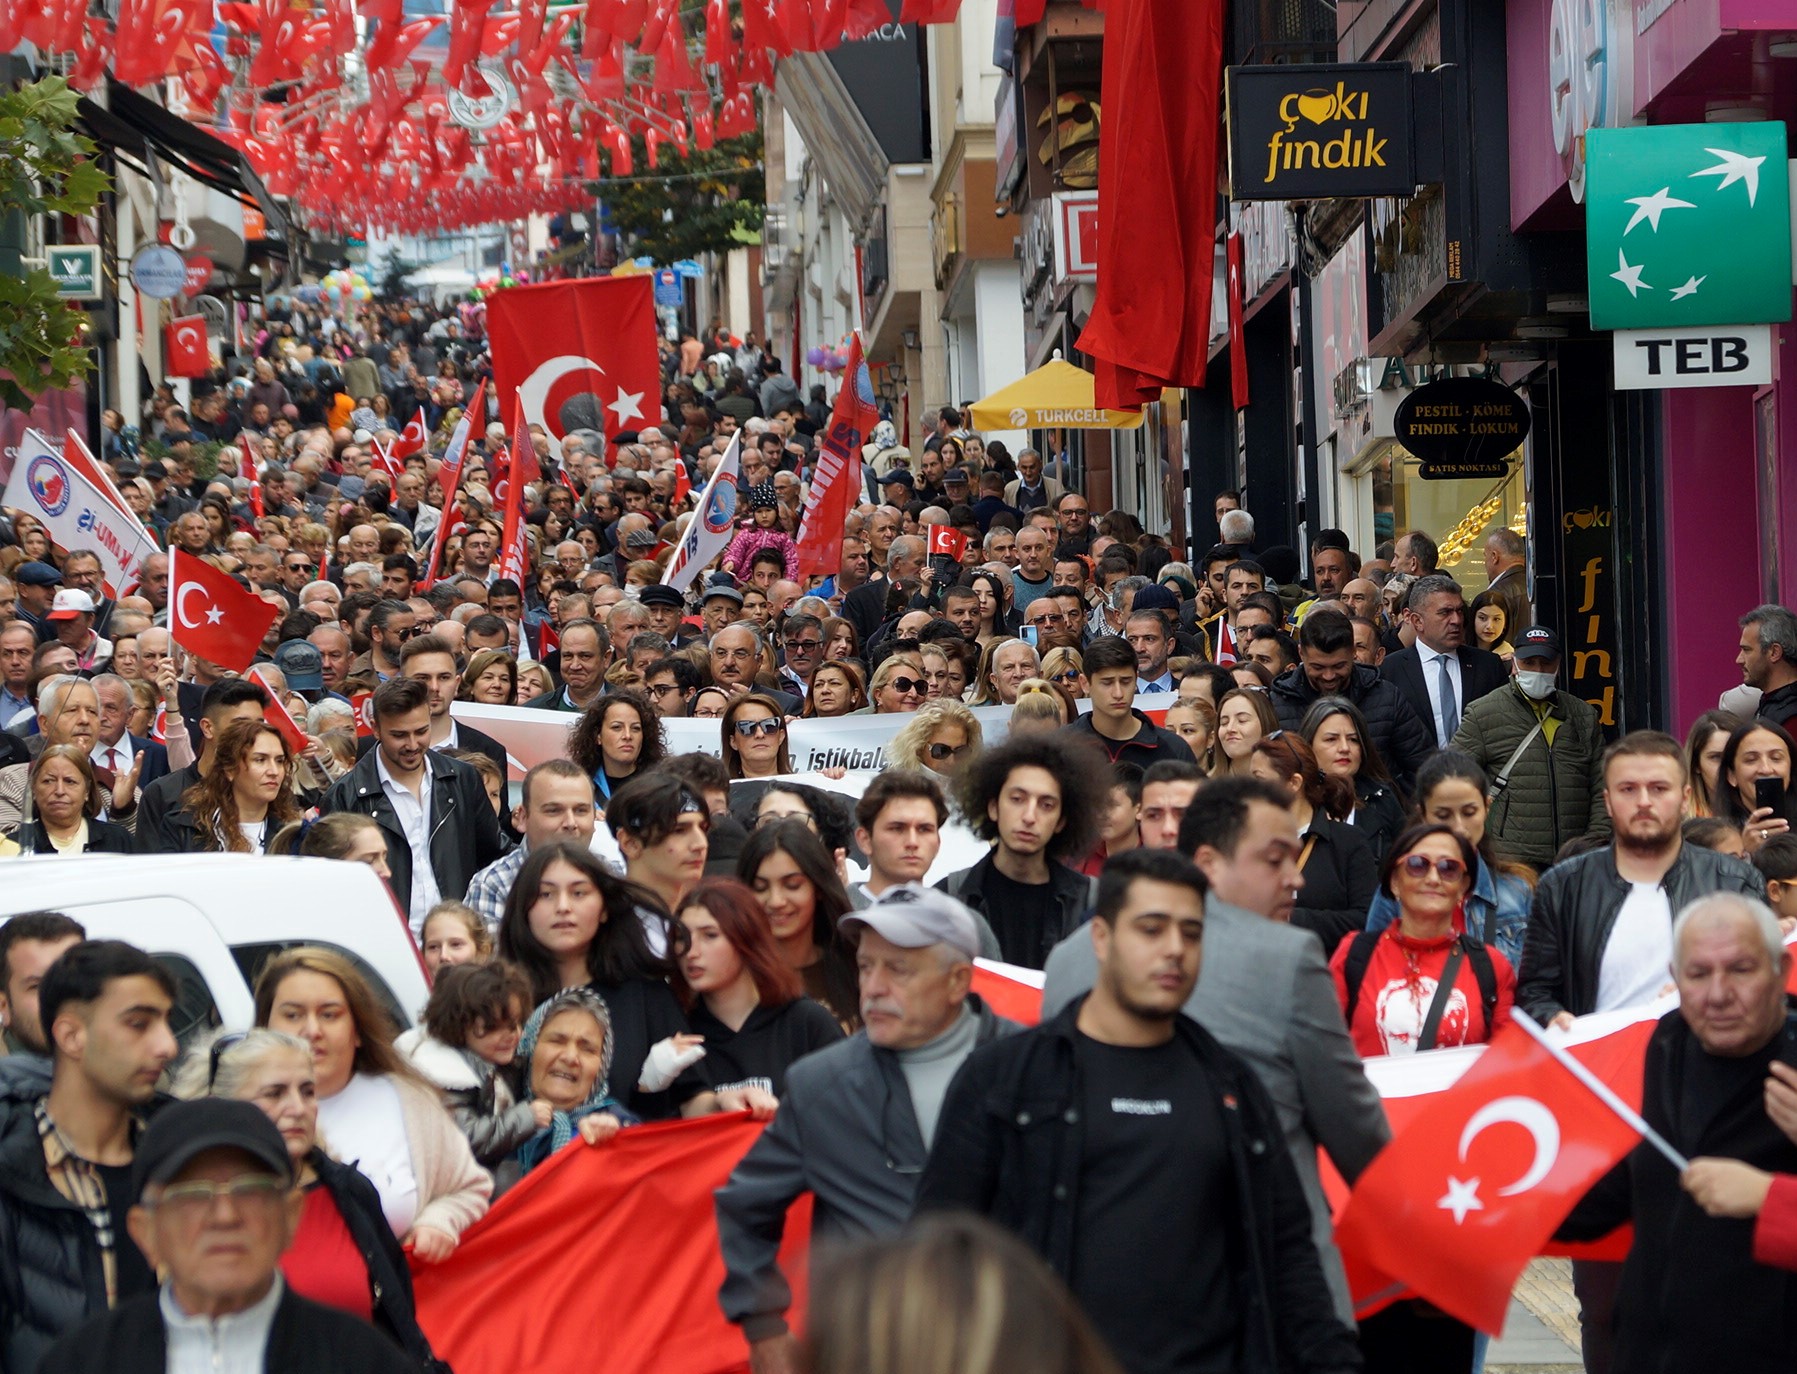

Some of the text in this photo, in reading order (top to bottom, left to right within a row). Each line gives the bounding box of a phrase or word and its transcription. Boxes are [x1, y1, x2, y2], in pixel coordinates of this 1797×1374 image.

[1264, 128, 1388, 183] fındık
[1635, 337, 1749, 375] TEB
[1035, 409, 1109, 422] TURKCELL
[1415, 401, 1513, 417] PESTİL KÖME
[1409, 422, 1518, 435] FINDIK LOKUM
[1429, 464, 1457, 472] SATIŞ
